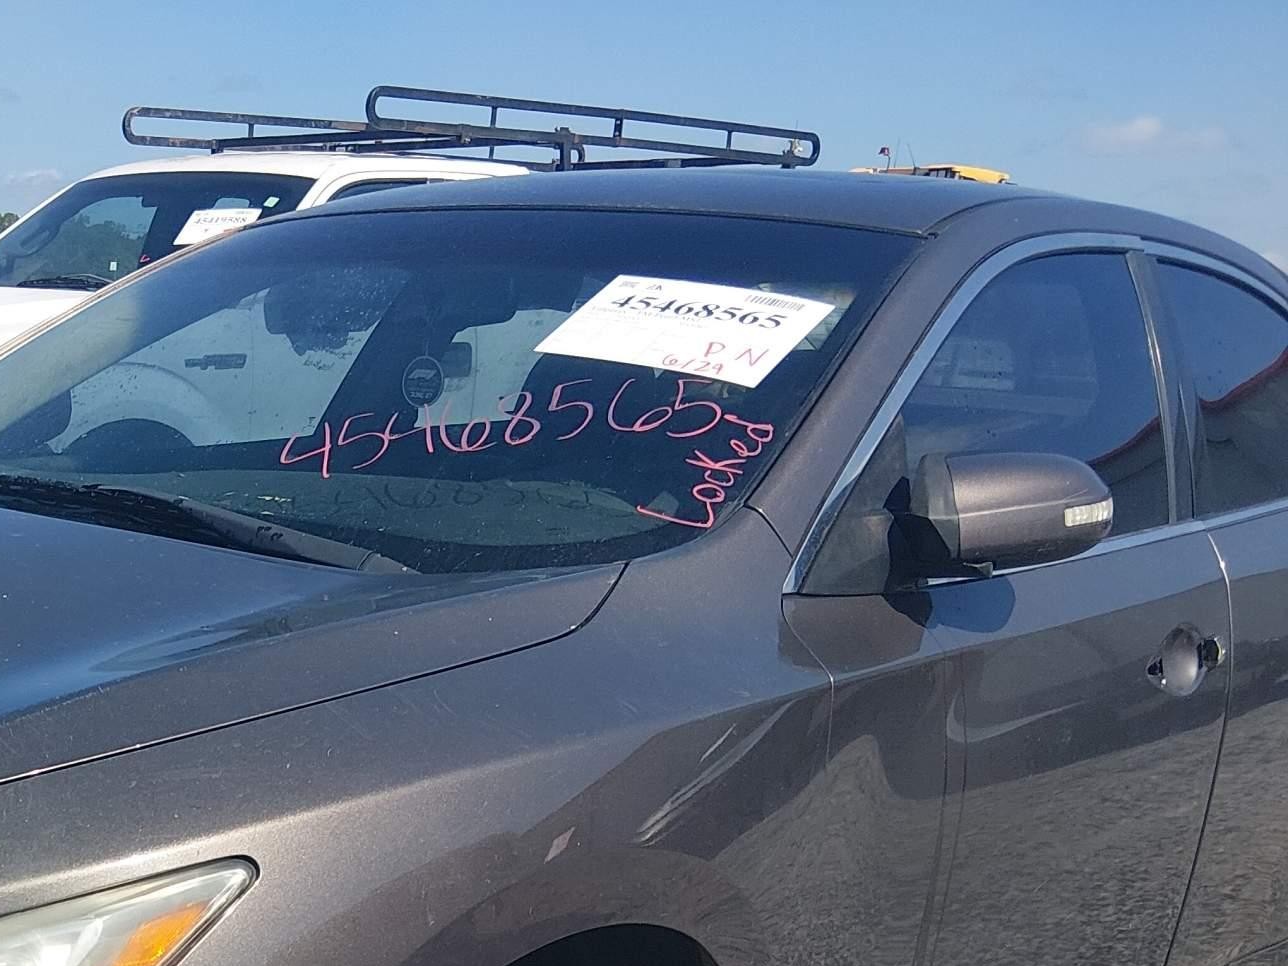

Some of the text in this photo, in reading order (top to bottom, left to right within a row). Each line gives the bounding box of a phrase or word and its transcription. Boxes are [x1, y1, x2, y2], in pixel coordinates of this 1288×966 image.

[611, 294, 788, 329] 45468565
[734, 348, 769, 367] N
[279, 378, 722, 478] 45468565
